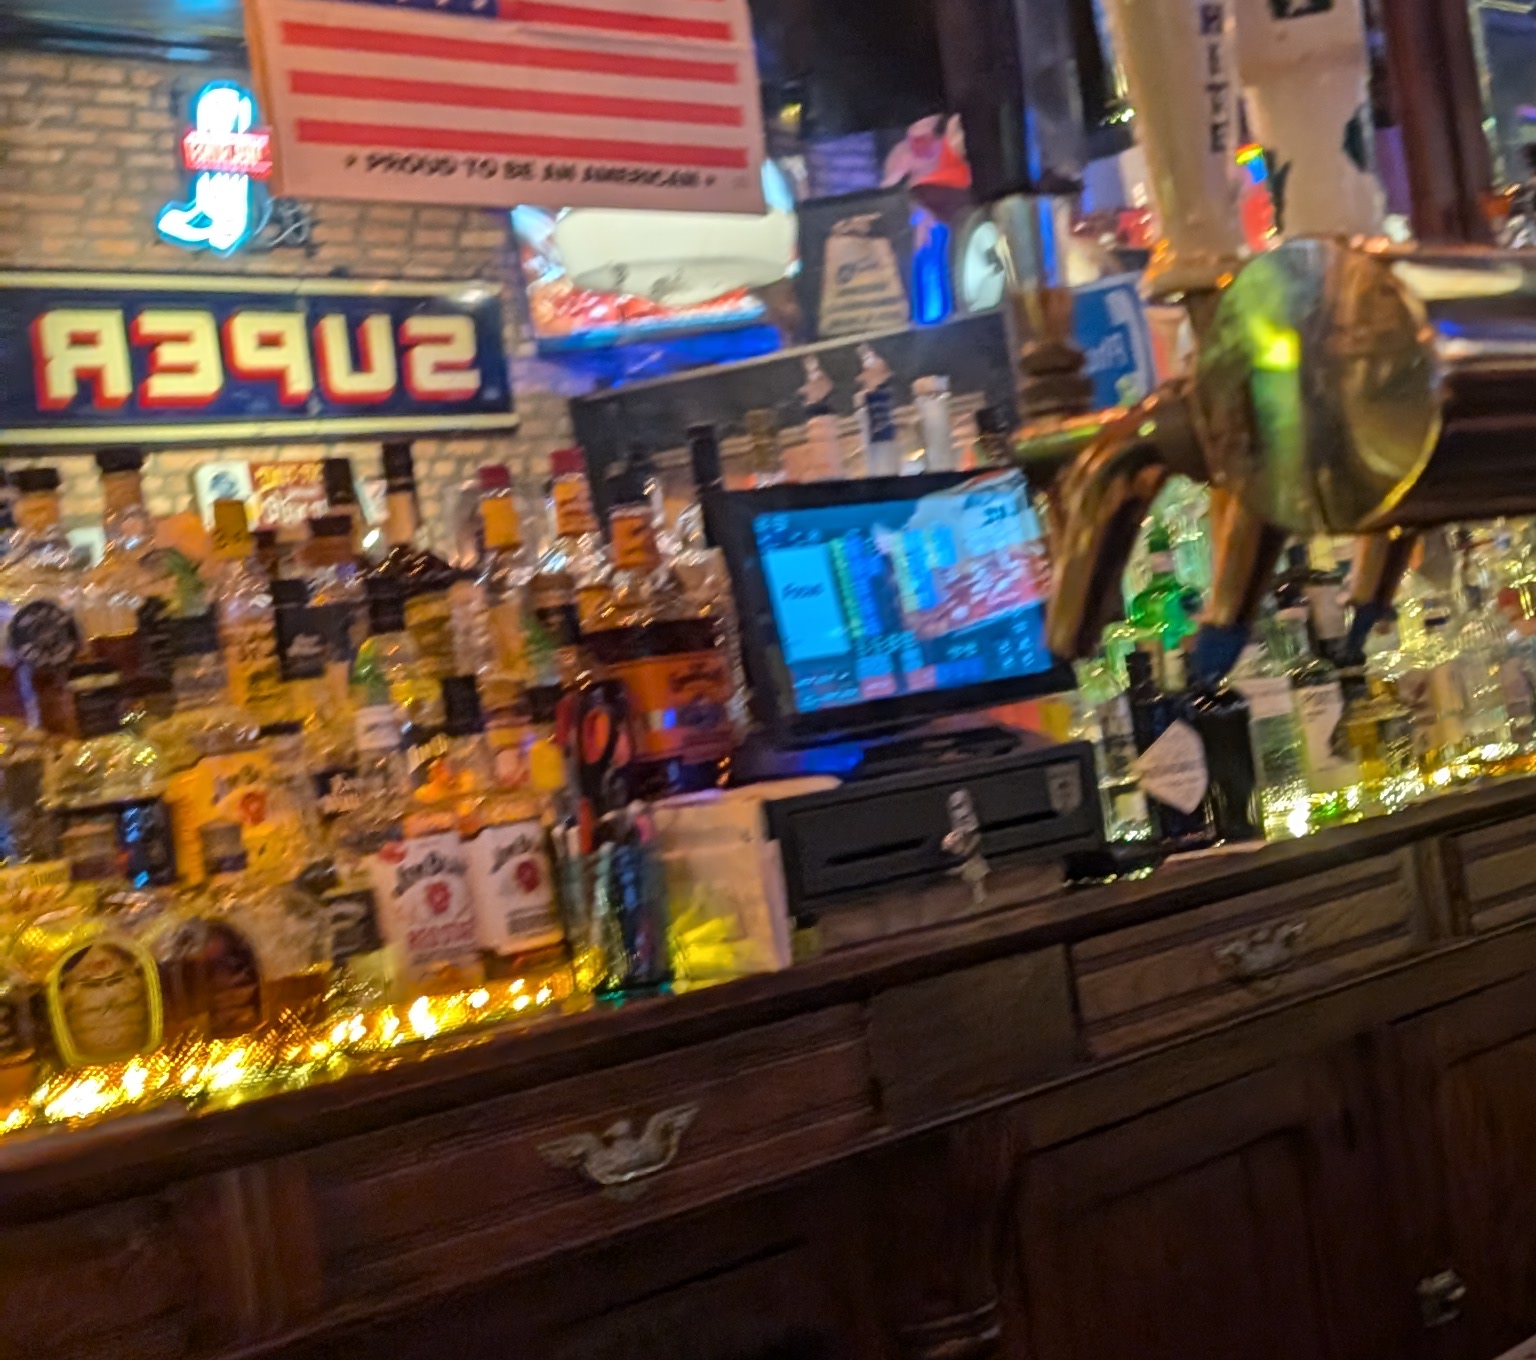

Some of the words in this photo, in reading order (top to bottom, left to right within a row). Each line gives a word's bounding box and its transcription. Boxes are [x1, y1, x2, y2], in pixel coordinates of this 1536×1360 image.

[365, 152, 458, 176] PROUD
[461, 156, 499, 179] TO
[502, 158, 536, 181] BE
[540, 161, 578, 183] AN
[580, 163, 700, 188] AMERICAN
